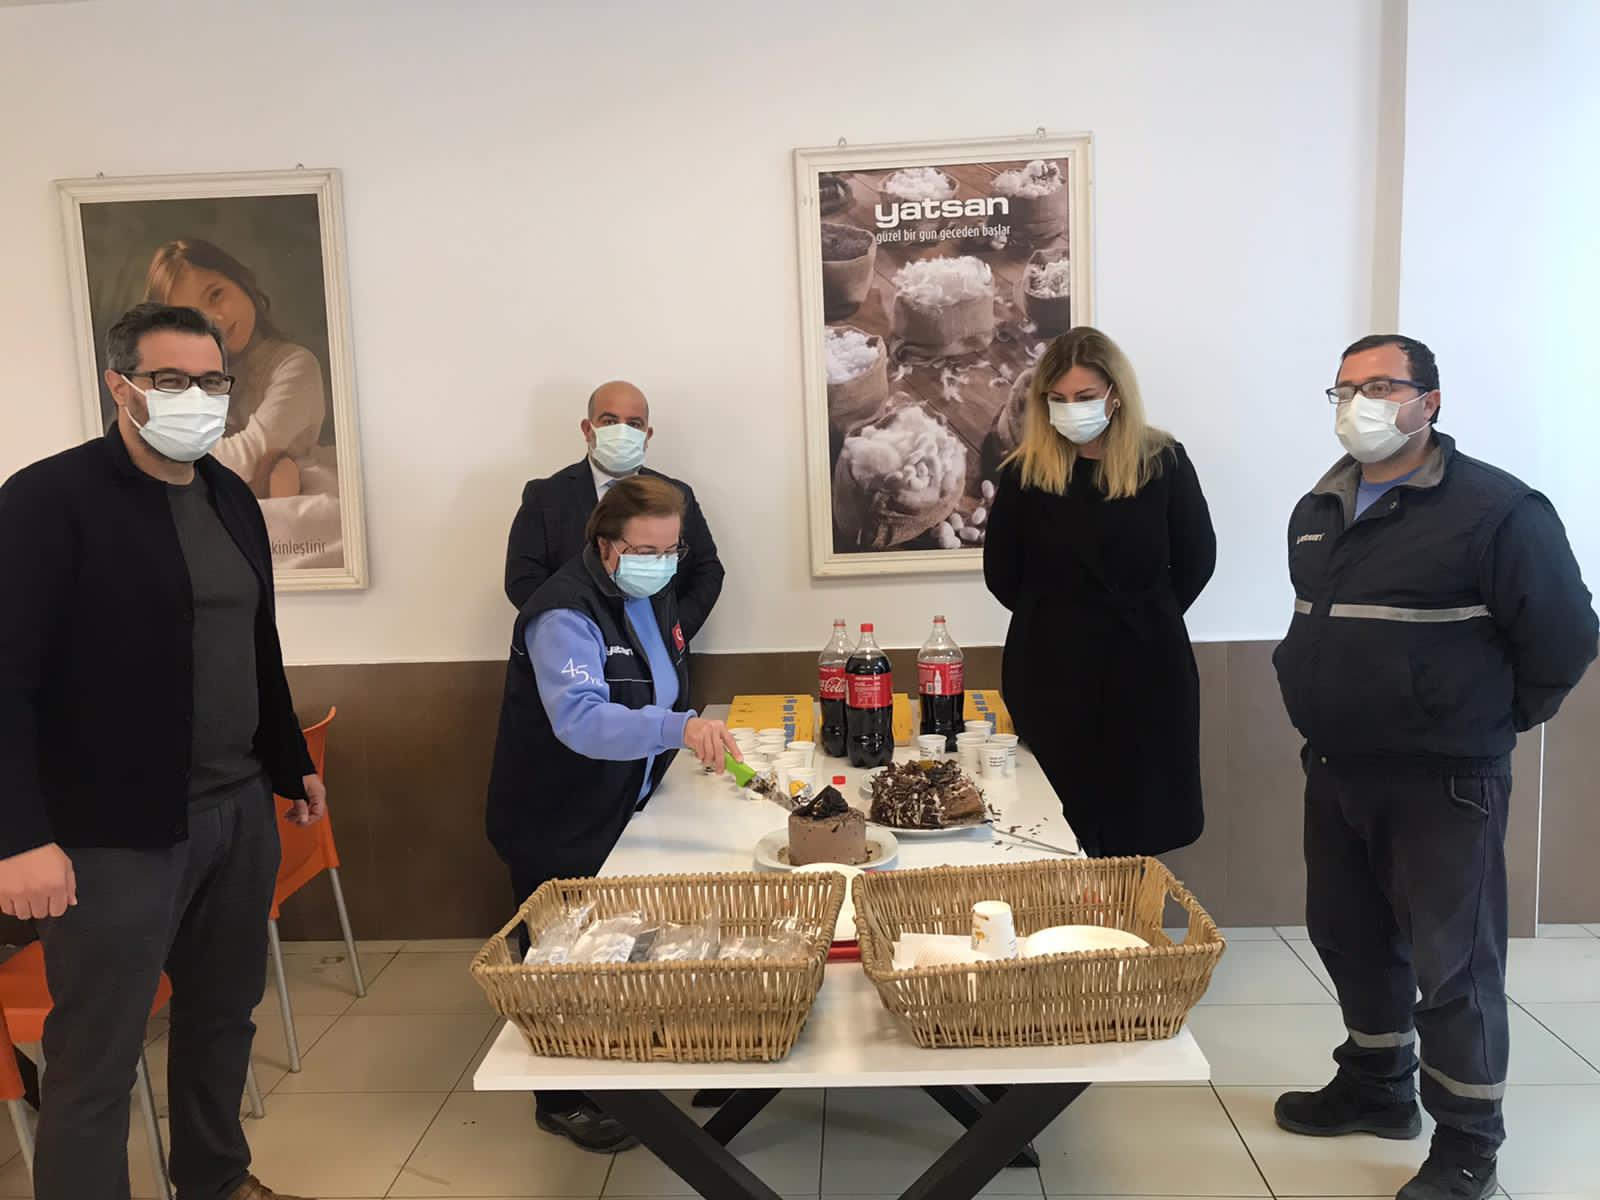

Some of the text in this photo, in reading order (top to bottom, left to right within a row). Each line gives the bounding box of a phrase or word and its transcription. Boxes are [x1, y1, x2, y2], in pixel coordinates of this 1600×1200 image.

[875, 197, 1009, 229] yatsan
[904, 229, 916, 241] bir
[940, 226, 980, 241] geceden
[271, 539, 326, 557] kinleştirir
[560, 657, 590, 685] 45
